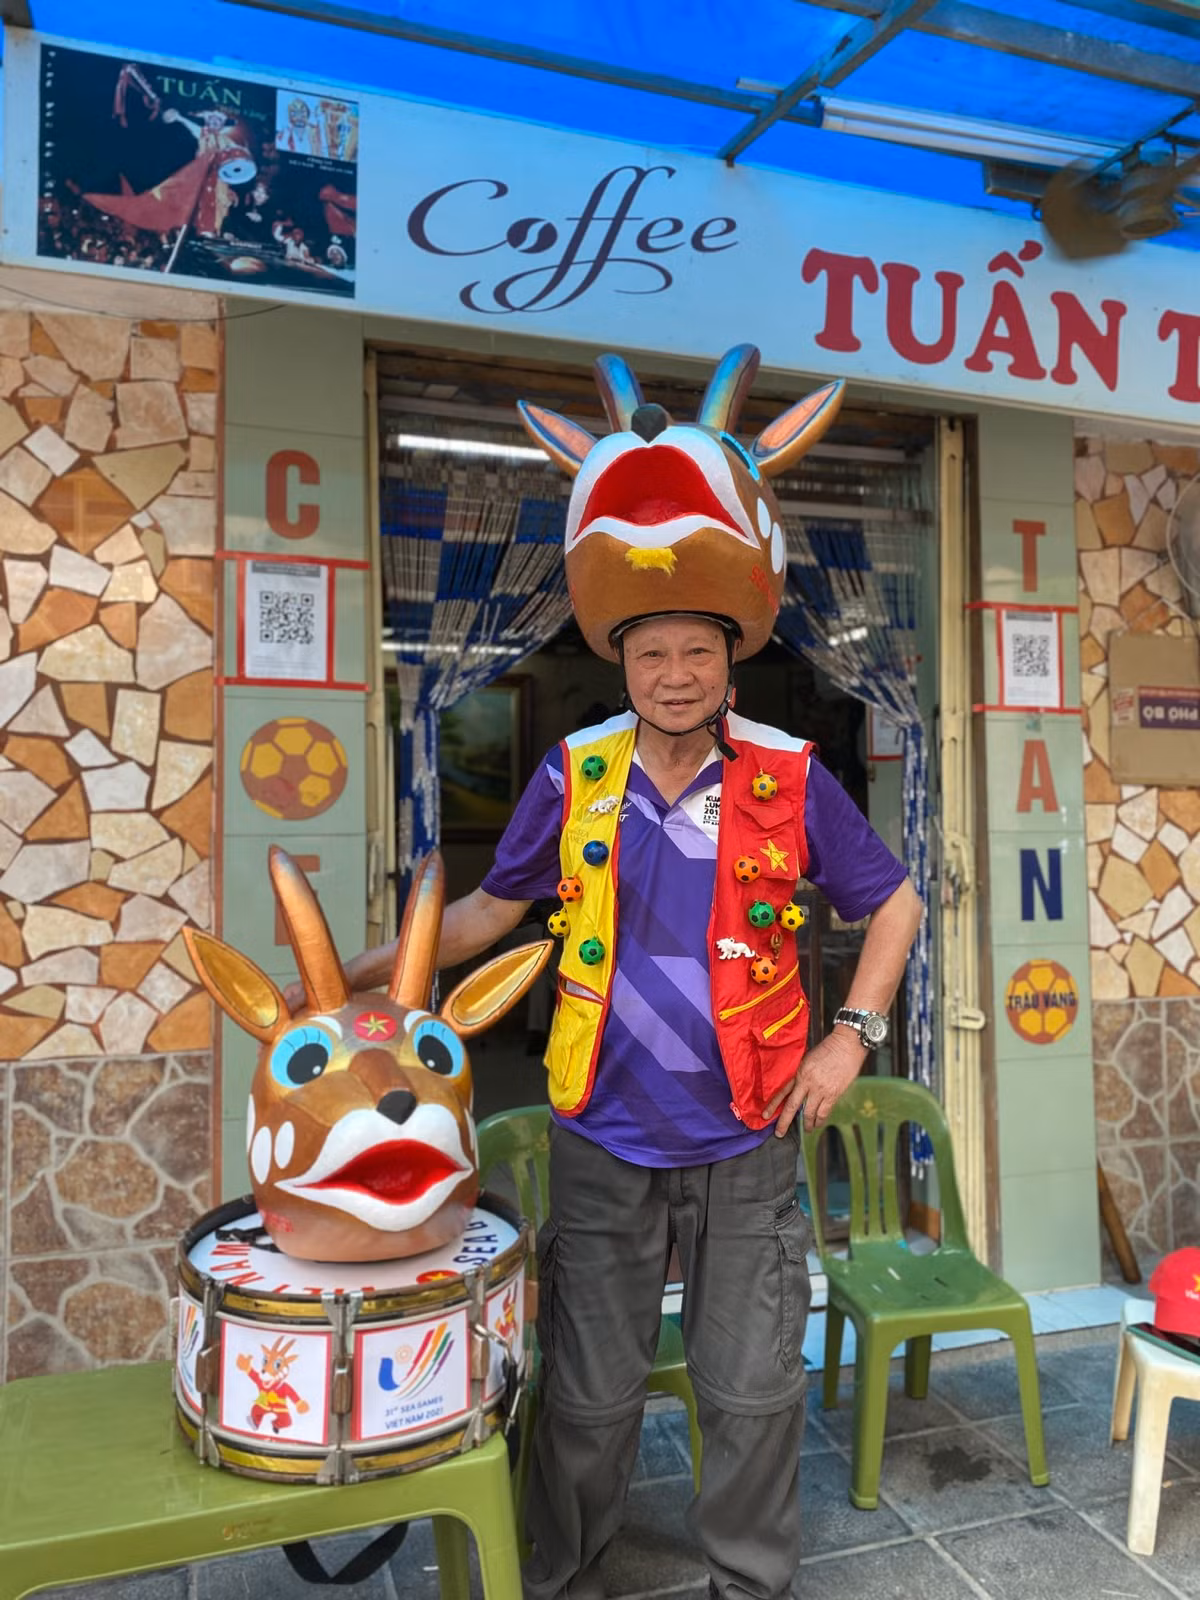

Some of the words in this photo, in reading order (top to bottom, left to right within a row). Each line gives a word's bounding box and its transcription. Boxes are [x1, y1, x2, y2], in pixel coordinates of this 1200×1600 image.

[156, 75, 242, 106] TUẤN
[407, 165, 739, 313] Coffee
[802, 240, 1127, 392] TUẤN
[453, 1234, 498, 1265] SEA
[401, 1404, 416, 1414] SEA
[417, 1396, 443, 1409] GAMES
[405, 1412, 424, 1424] NAM
